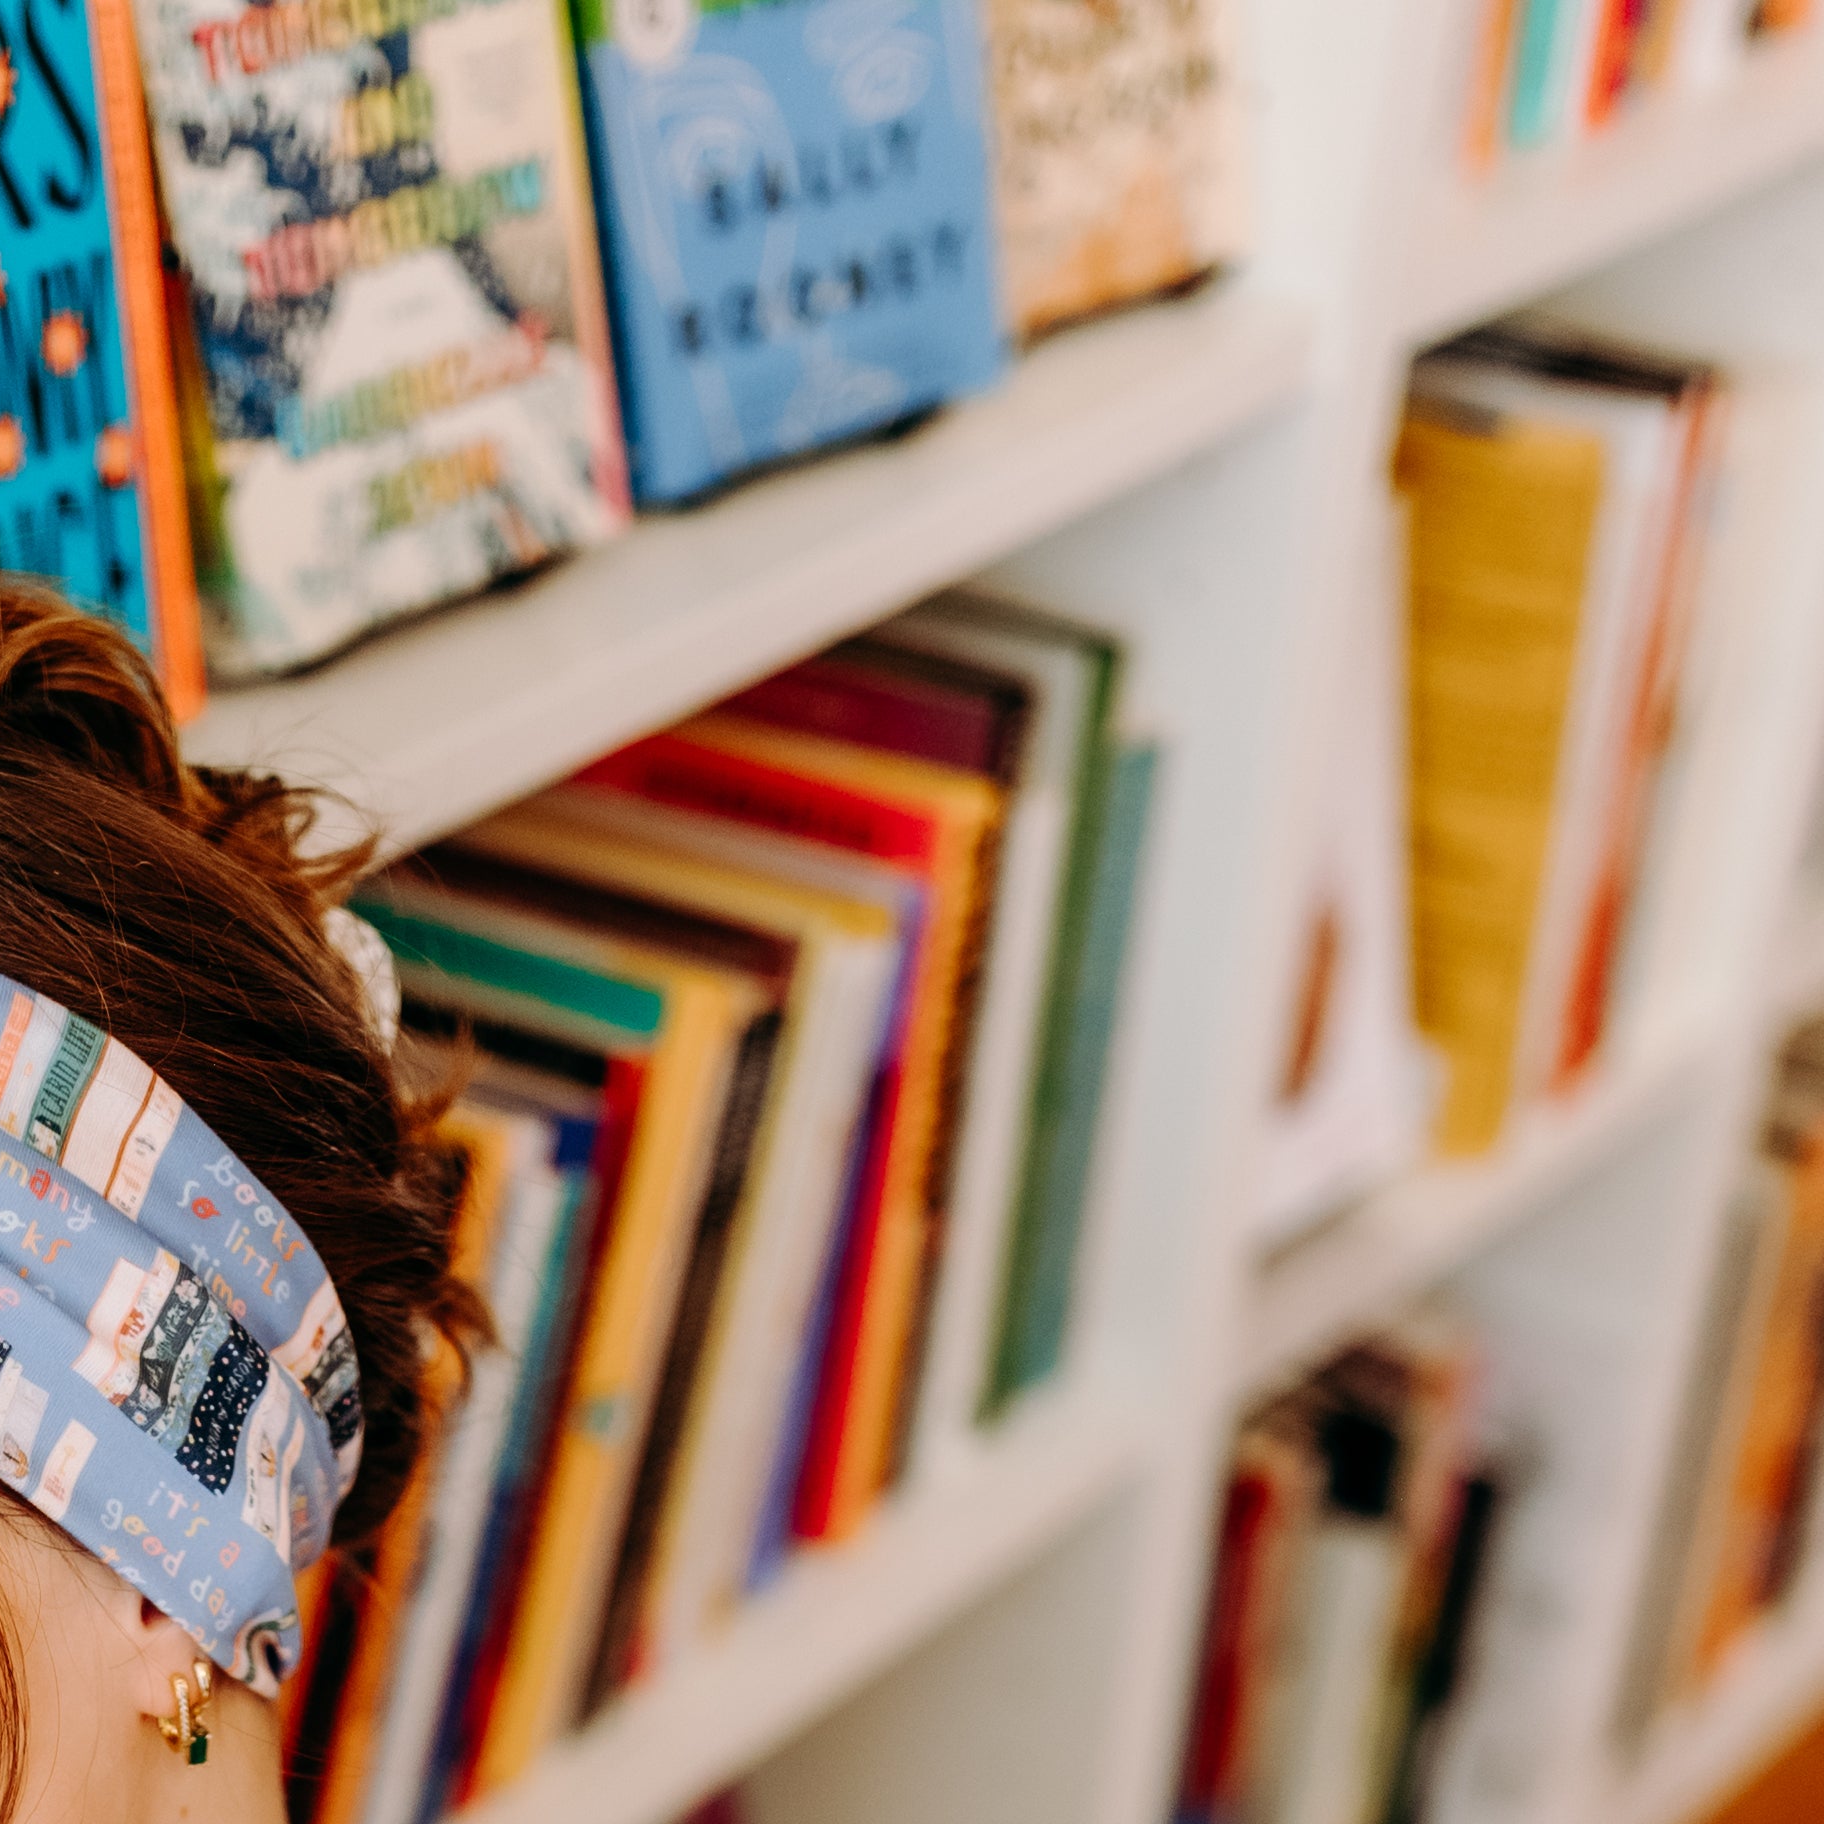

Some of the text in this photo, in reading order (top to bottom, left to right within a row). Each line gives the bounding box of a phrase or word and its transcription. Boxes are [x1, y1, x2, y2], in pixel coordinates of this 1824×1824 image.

[175, 1180, 291, 1304] so little
[202, 1153, 306, 1262] books
[188, 1243, 247, 1320] time
[100, 1497, 187, 1578] good
[188, 1575, 236, 1632] day
[147, 1480, 211, 1538] it's
[218, 1540, 241, 1570] a
